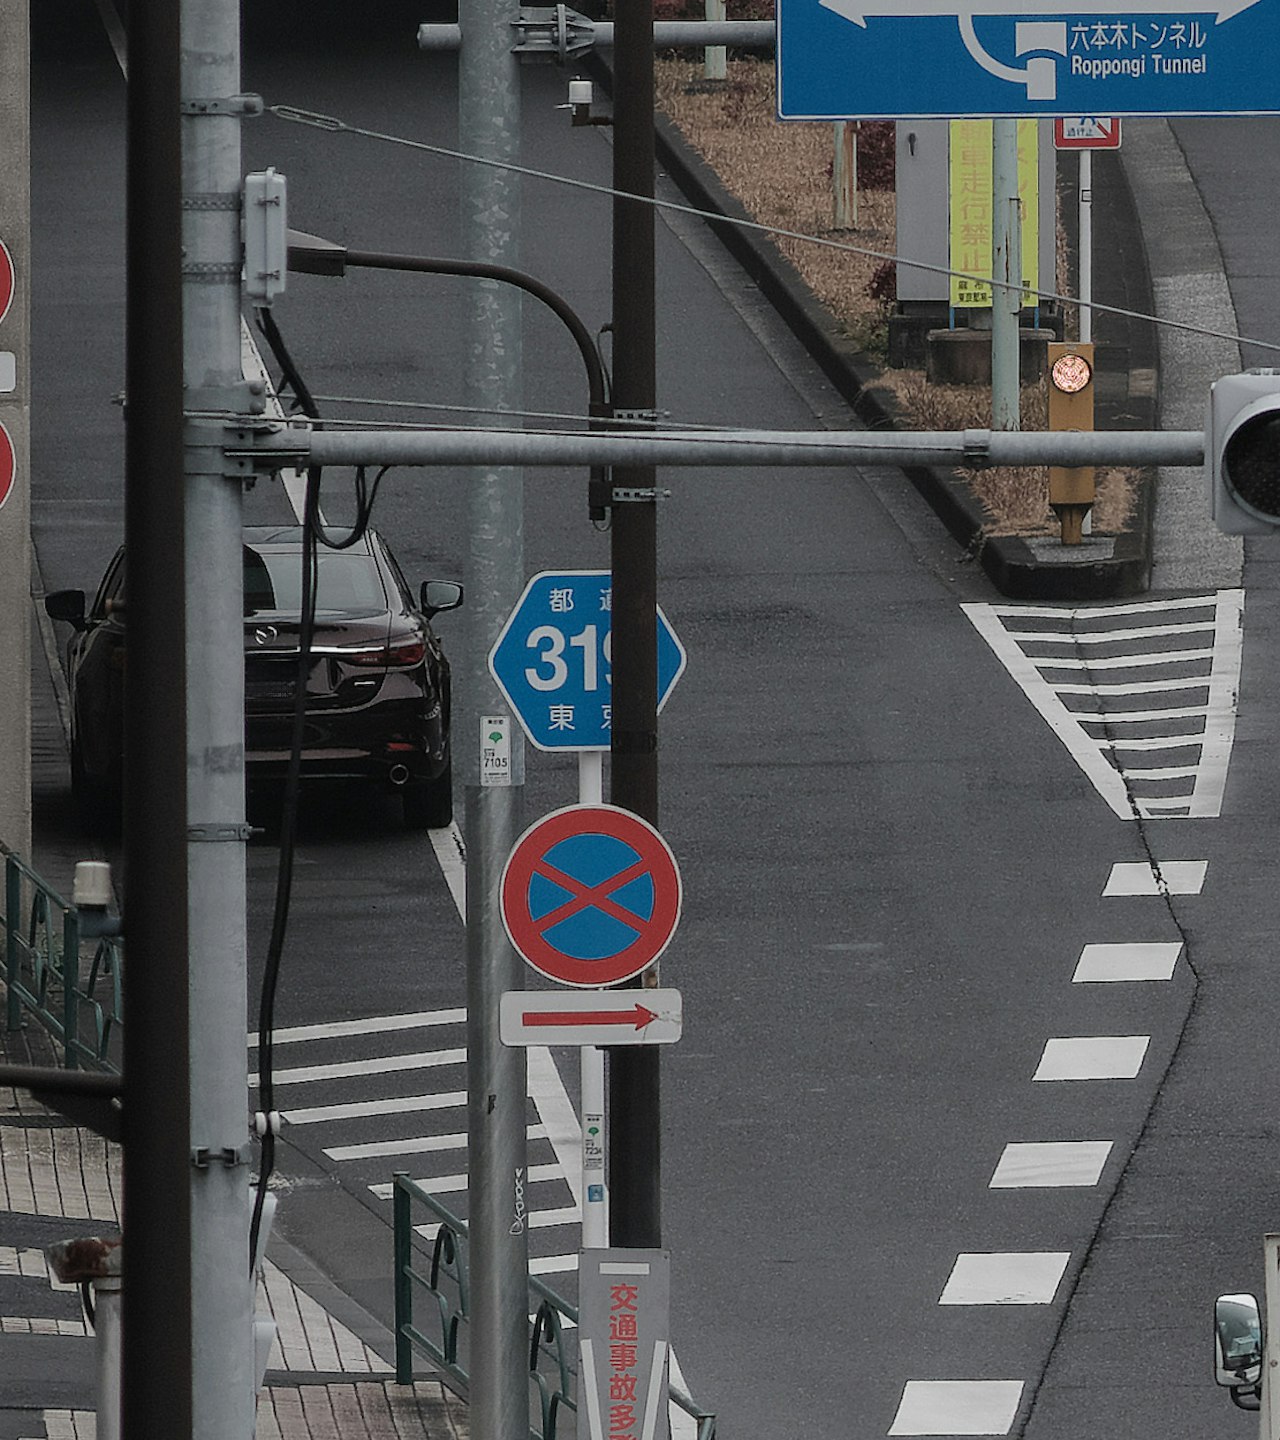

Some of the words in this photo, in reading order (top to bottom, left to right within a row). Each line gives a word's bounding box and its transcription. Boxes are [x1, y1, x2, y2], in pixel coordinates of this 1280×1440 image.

[1070, 21, 1208, 52] 六本木トンネル
[1071, 53, 1147, 78] Roppongi
[1150, 52, 1208, 76] Tunnel
[524, 623, 612, 693] 31
[484, 757, 509, 768] 7105
